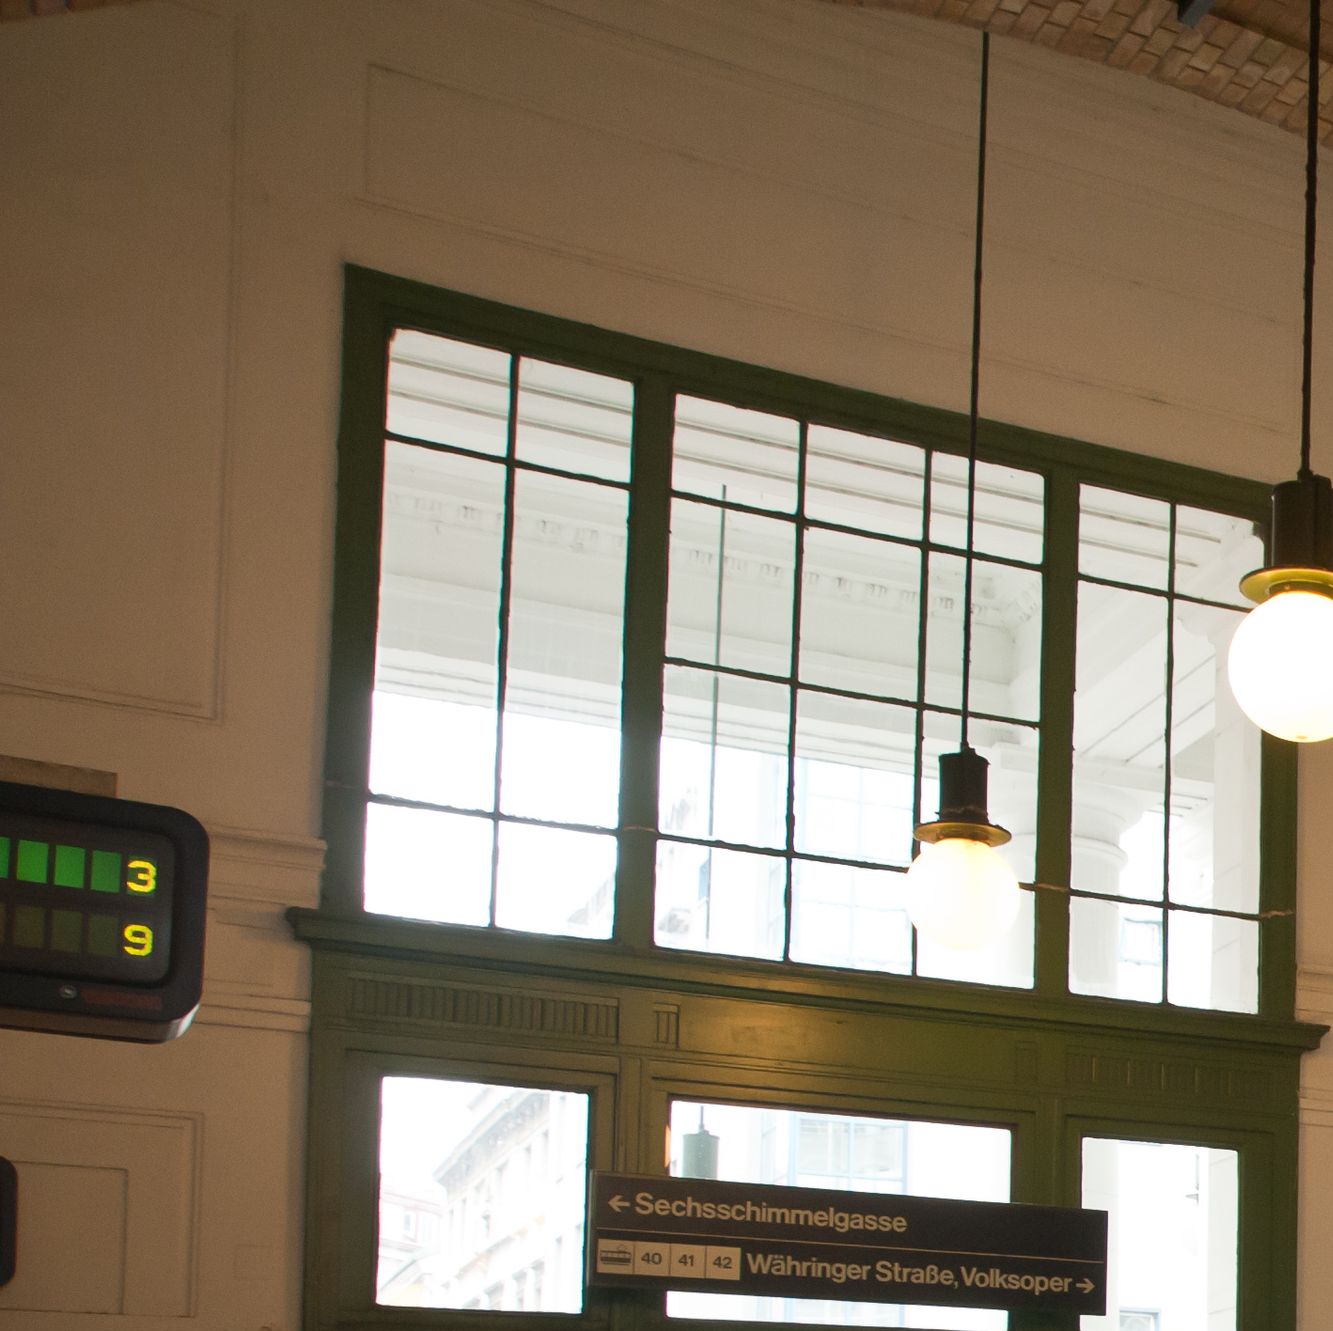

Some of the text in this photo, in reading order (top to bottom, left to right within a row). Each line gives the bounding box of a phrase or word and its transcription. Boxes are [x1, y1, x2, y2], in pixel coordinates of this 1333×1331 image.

[127, 860, 157, 893] 3
[123, 924, 154, 956] 9
[635, 1192, 907, 1233] Sechsschimmelgasse
[641, 1252, 1073, 1295] 40 41 42 Währinger Straße, Volksoper
